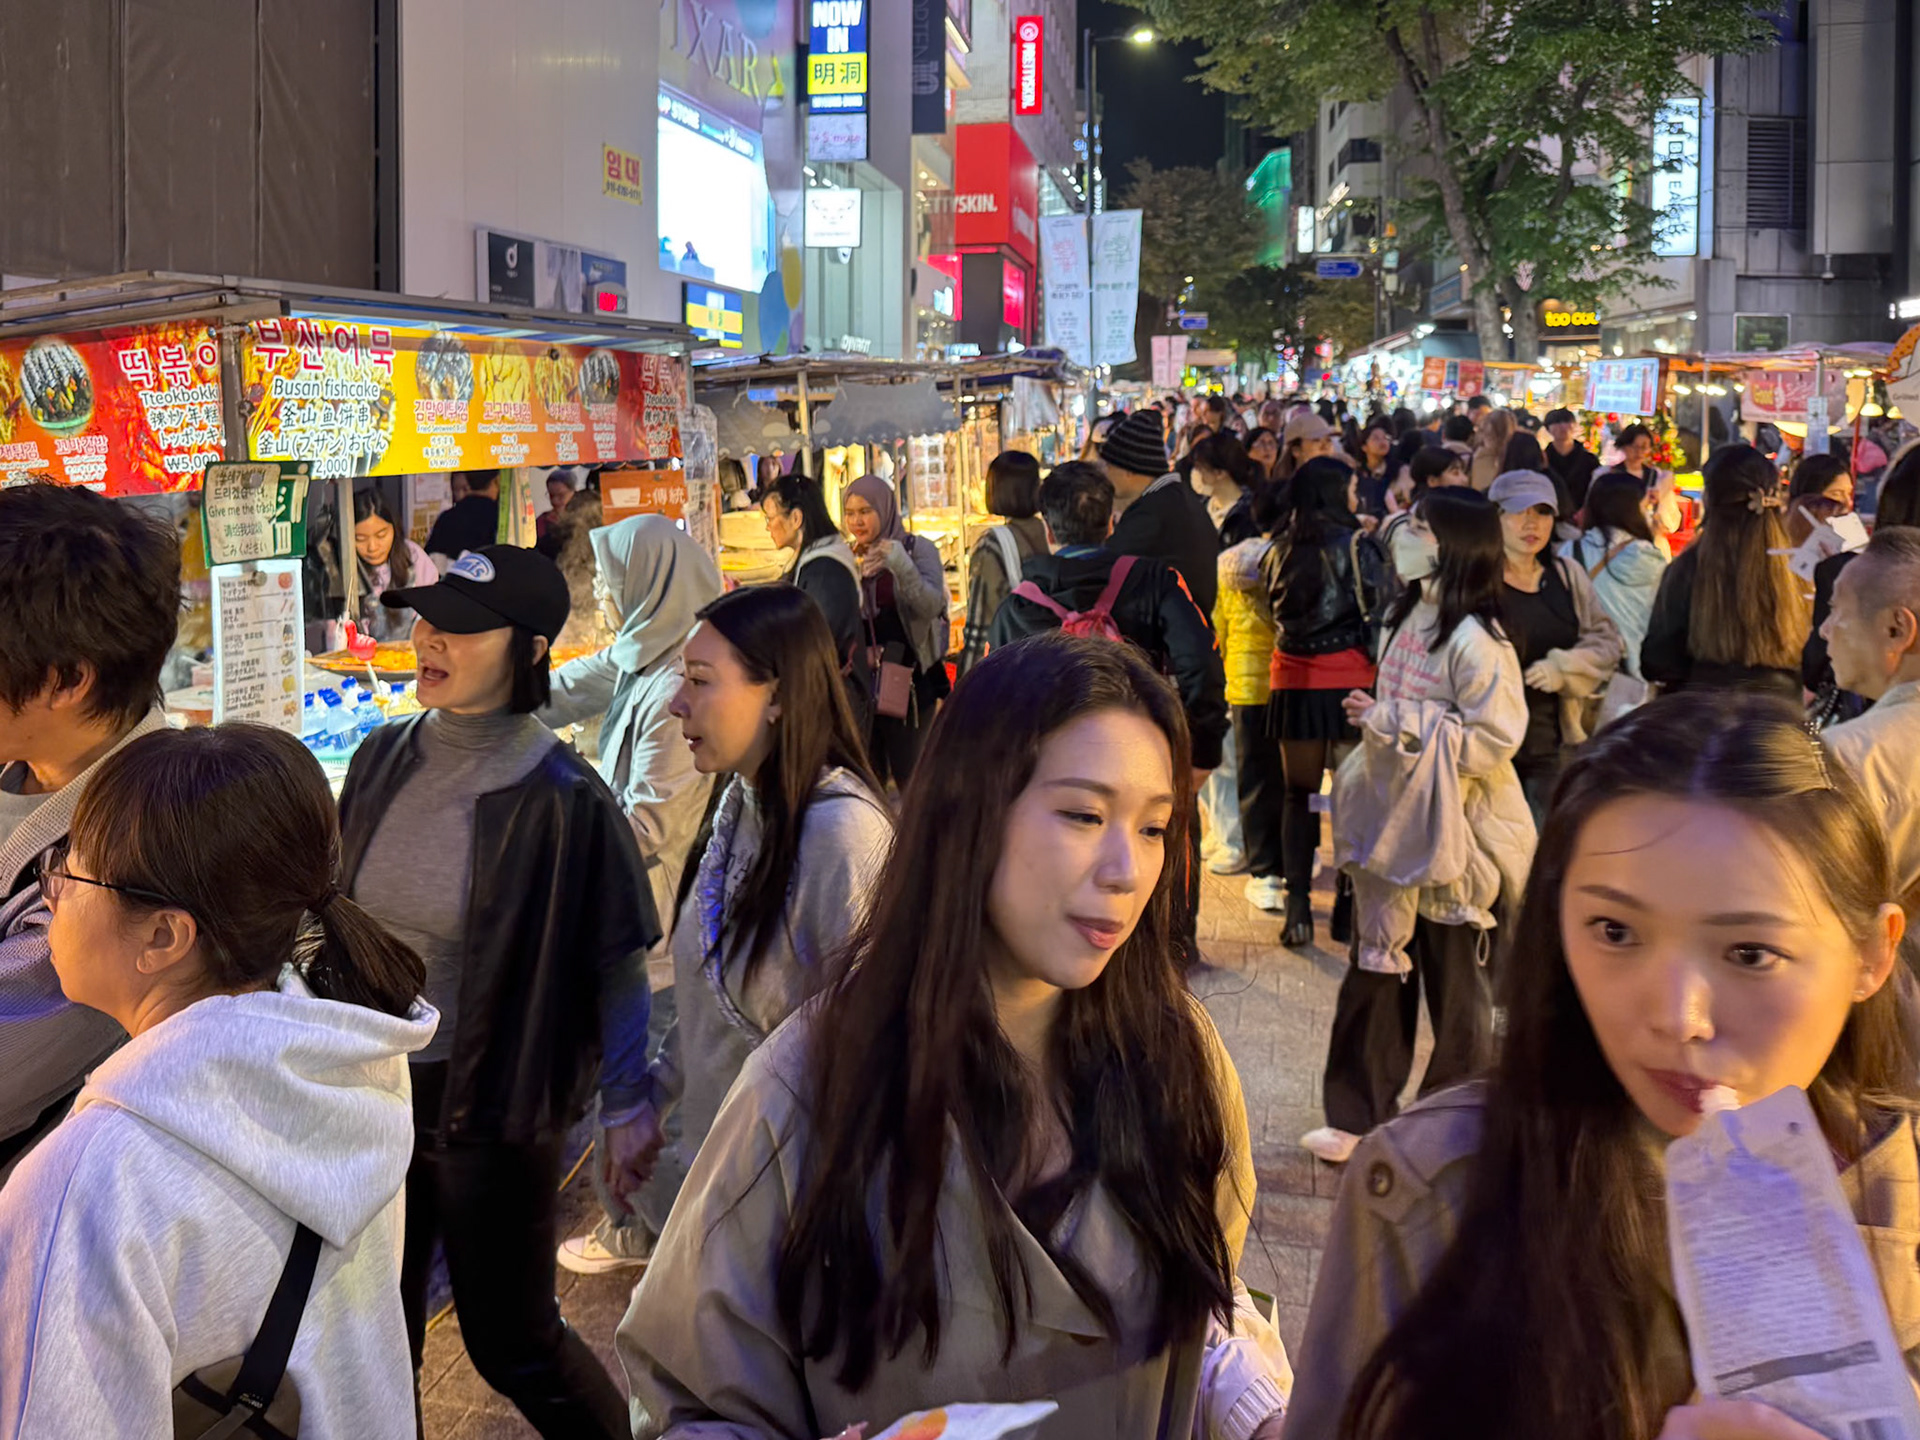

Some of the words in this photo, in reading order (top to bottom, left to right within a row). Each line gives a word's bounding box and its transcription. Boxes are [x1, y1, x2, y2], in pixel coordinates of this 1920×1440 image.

[812, 1, 863, 27] NOW
[827, 27, 849, 53] IN
[814, 62, 861, 85] 明洞
[606, 150, 640, 187] 임대
[254, 320, 395, 374] 부산어묵
[140, 385, 218, 407] Tteokbokki
[273, 378, 320, 397] Busan
[324, 378, 379, 398] fishcake
[150, 405, 219, 430] 辣炒年糕
[281, 402, 371, 428] 釜山鱼饼串
[159, 429, 219, 449] トッポッキ
[315, 458, 348, 475] 2,000
[208, 505, 226, 518] Give
[228, 506, 240, 517] me
[242, 504, 254, 515] the
